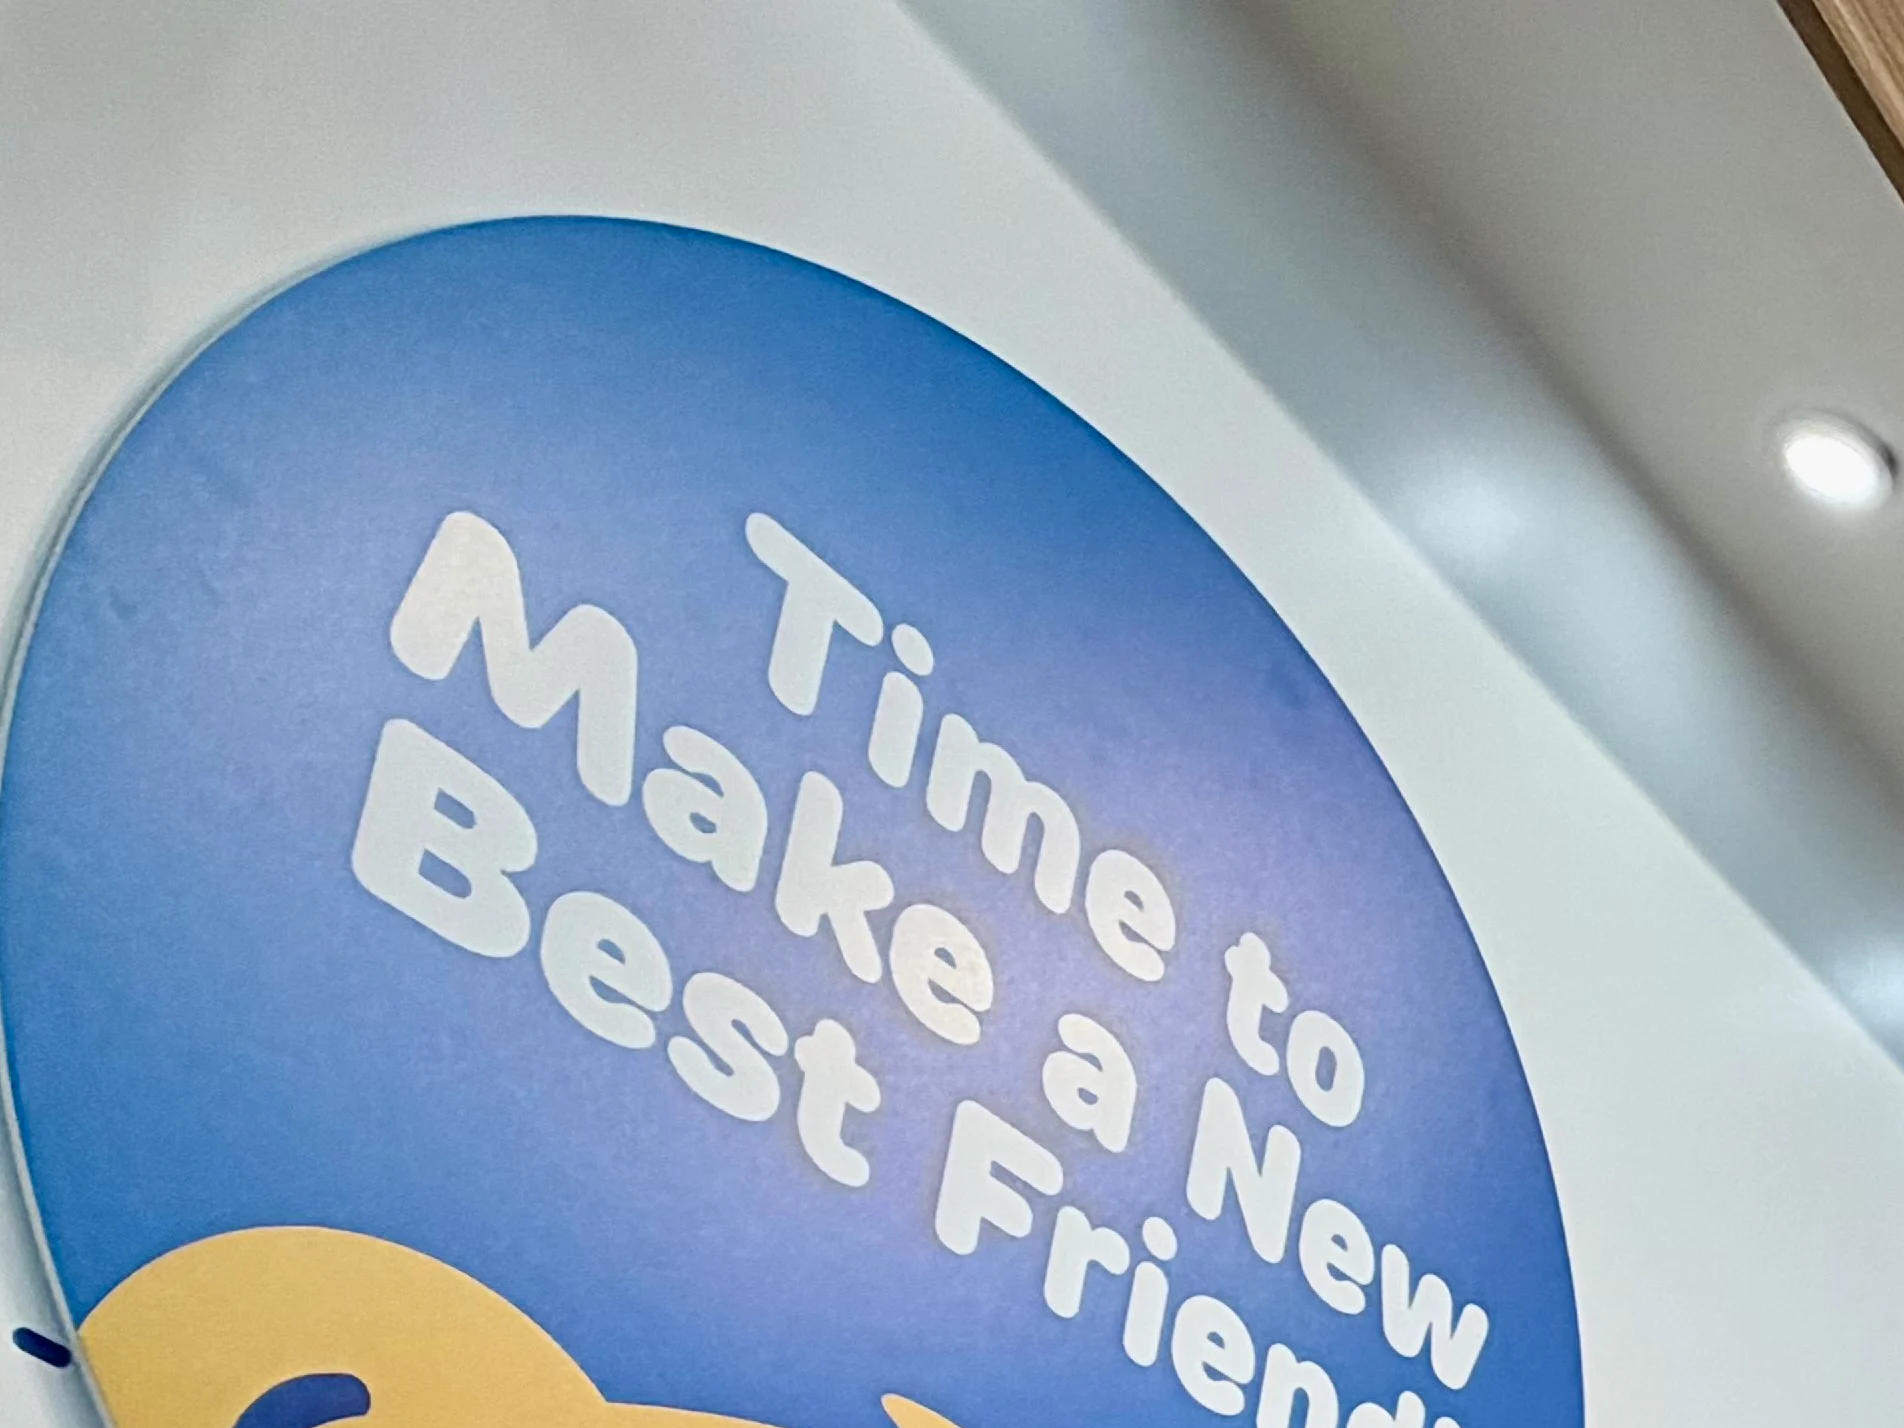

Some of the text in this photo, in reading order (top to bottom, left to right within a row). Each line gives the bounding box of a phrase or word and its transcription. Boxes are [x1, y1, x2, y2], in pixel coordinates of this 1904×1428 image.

[349, 718, 881, 1187] Best
[389, 511, 1489, 1390] Make a New
[745, 512, 1366, 1127] Time to
